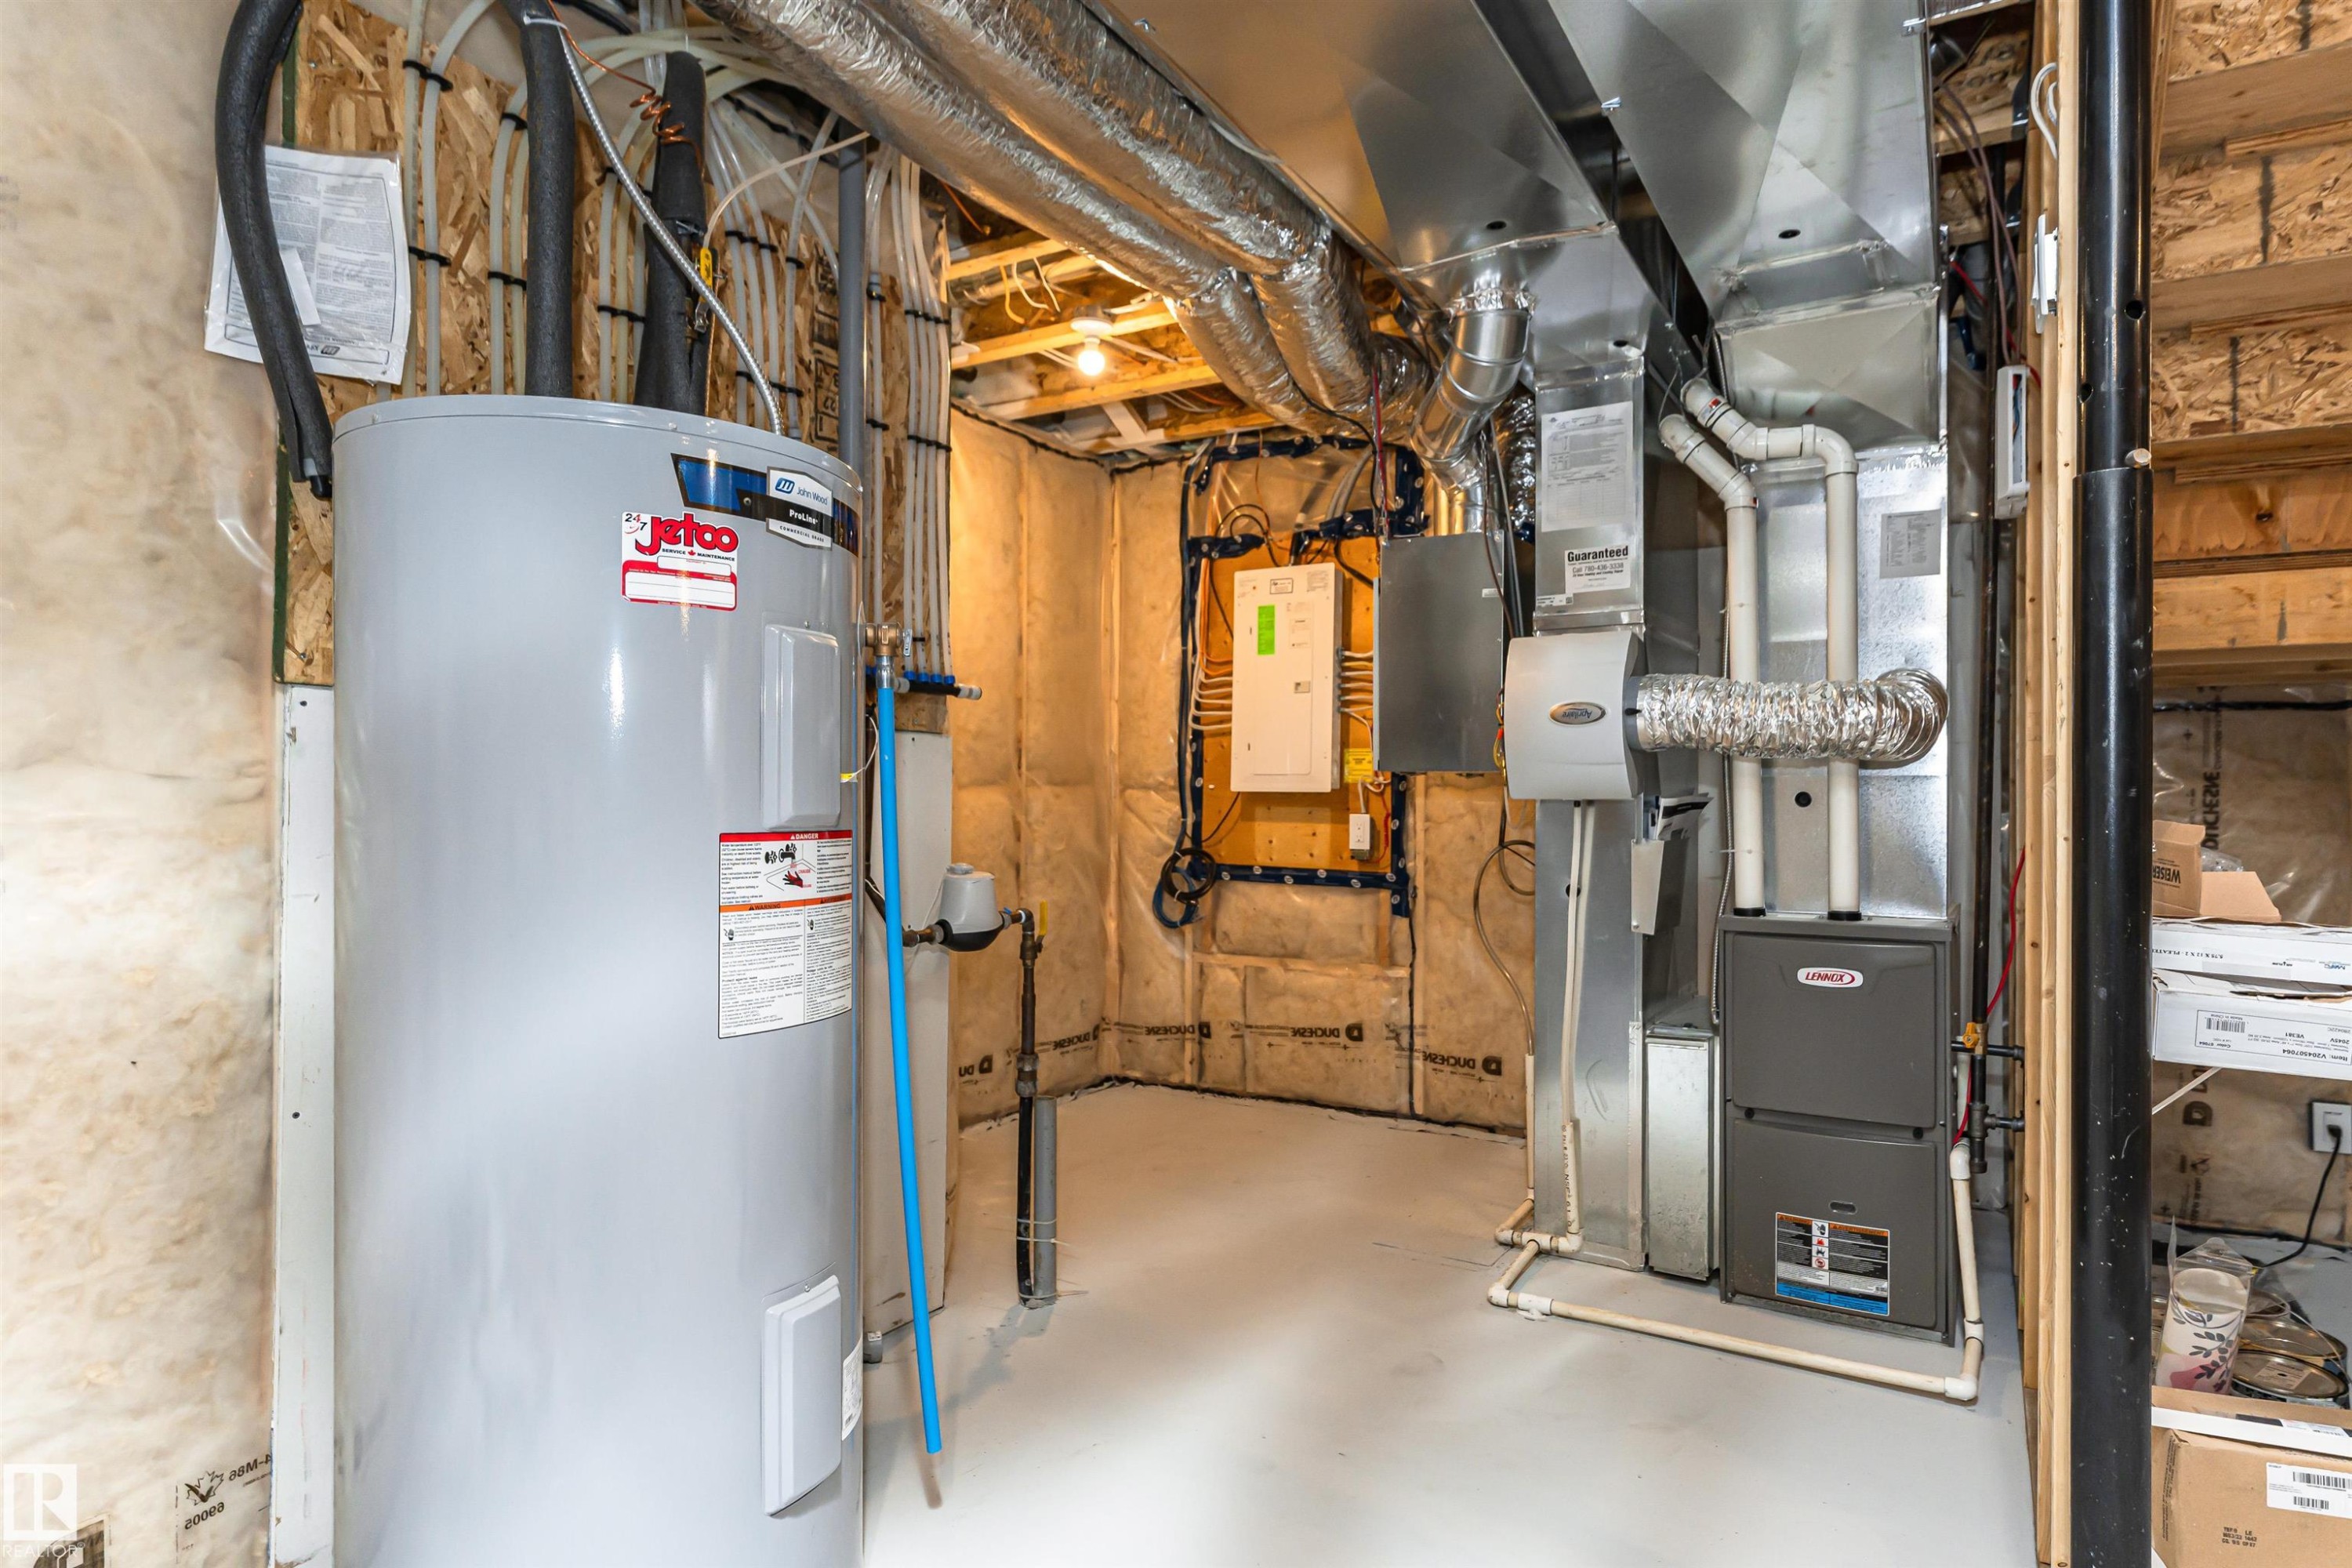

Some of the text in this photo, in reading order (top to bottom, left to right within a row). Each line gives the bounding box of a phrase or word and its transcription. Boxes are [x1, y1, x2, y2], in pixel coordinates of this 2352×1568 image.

[797, 487, 828, 506] John Wood
[779, 525, 810, 539] COMMERCIAL
[662, 547, 735, 562] SERVICE MAINTENANCE
[1567, 545, 1628, 562] Guaranteed
[1562, 709, 1592, 718] Aprilaire
[2152, 865, 2181, 884] WEISER
[1805, 971, 1846, 982] LENNOX
[2282, 1049, 2348, 1062] Item: V204507064
